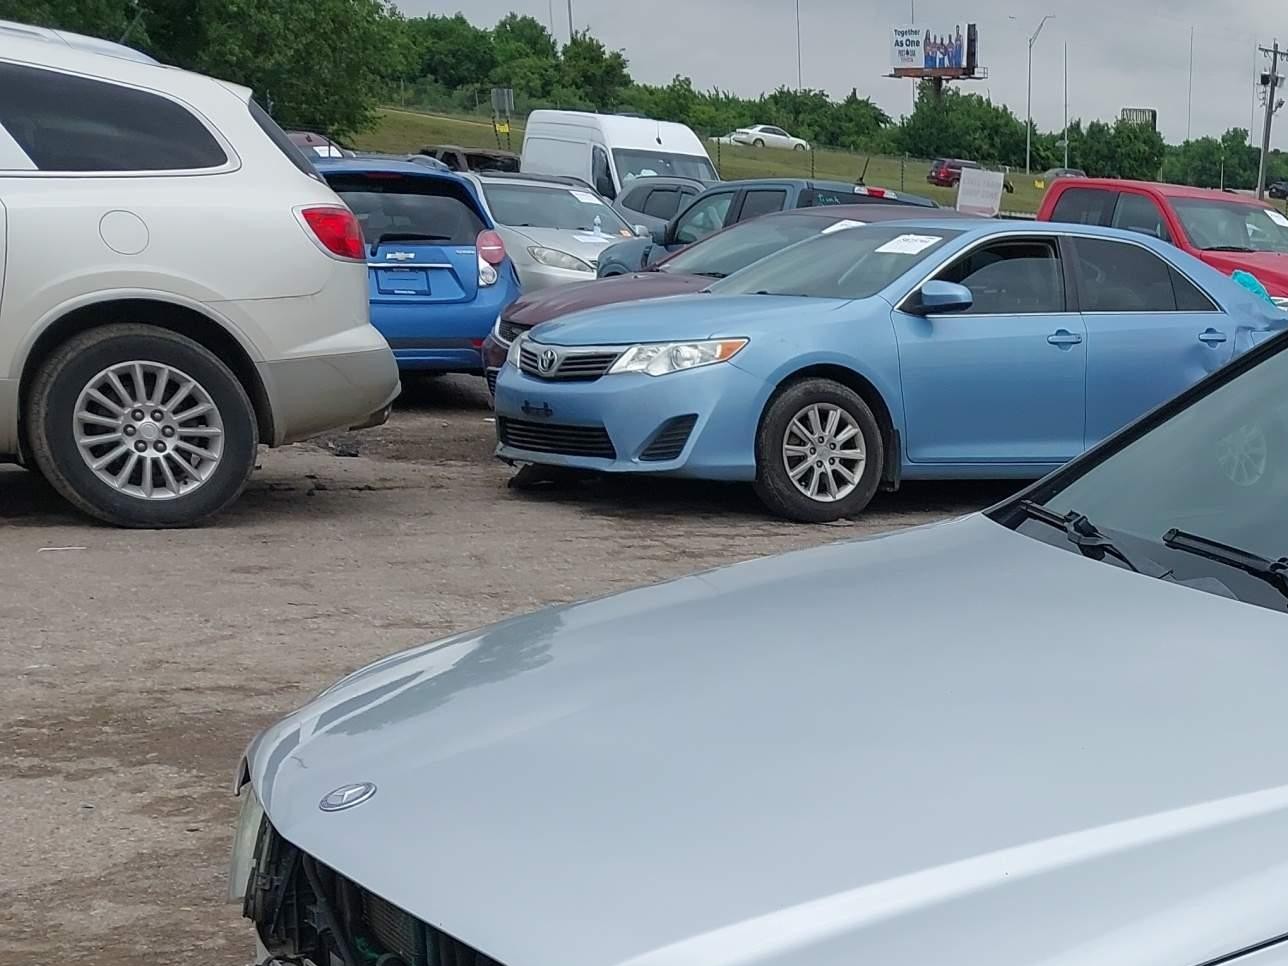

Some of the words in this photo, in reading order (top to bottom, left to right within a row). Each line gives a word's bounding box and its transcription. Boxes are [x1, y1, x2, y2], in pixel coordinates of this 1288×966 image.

[893, 29, 920, 37] Together
[894, 39, 904, 47] As
[905, 39, 920, 47] One
